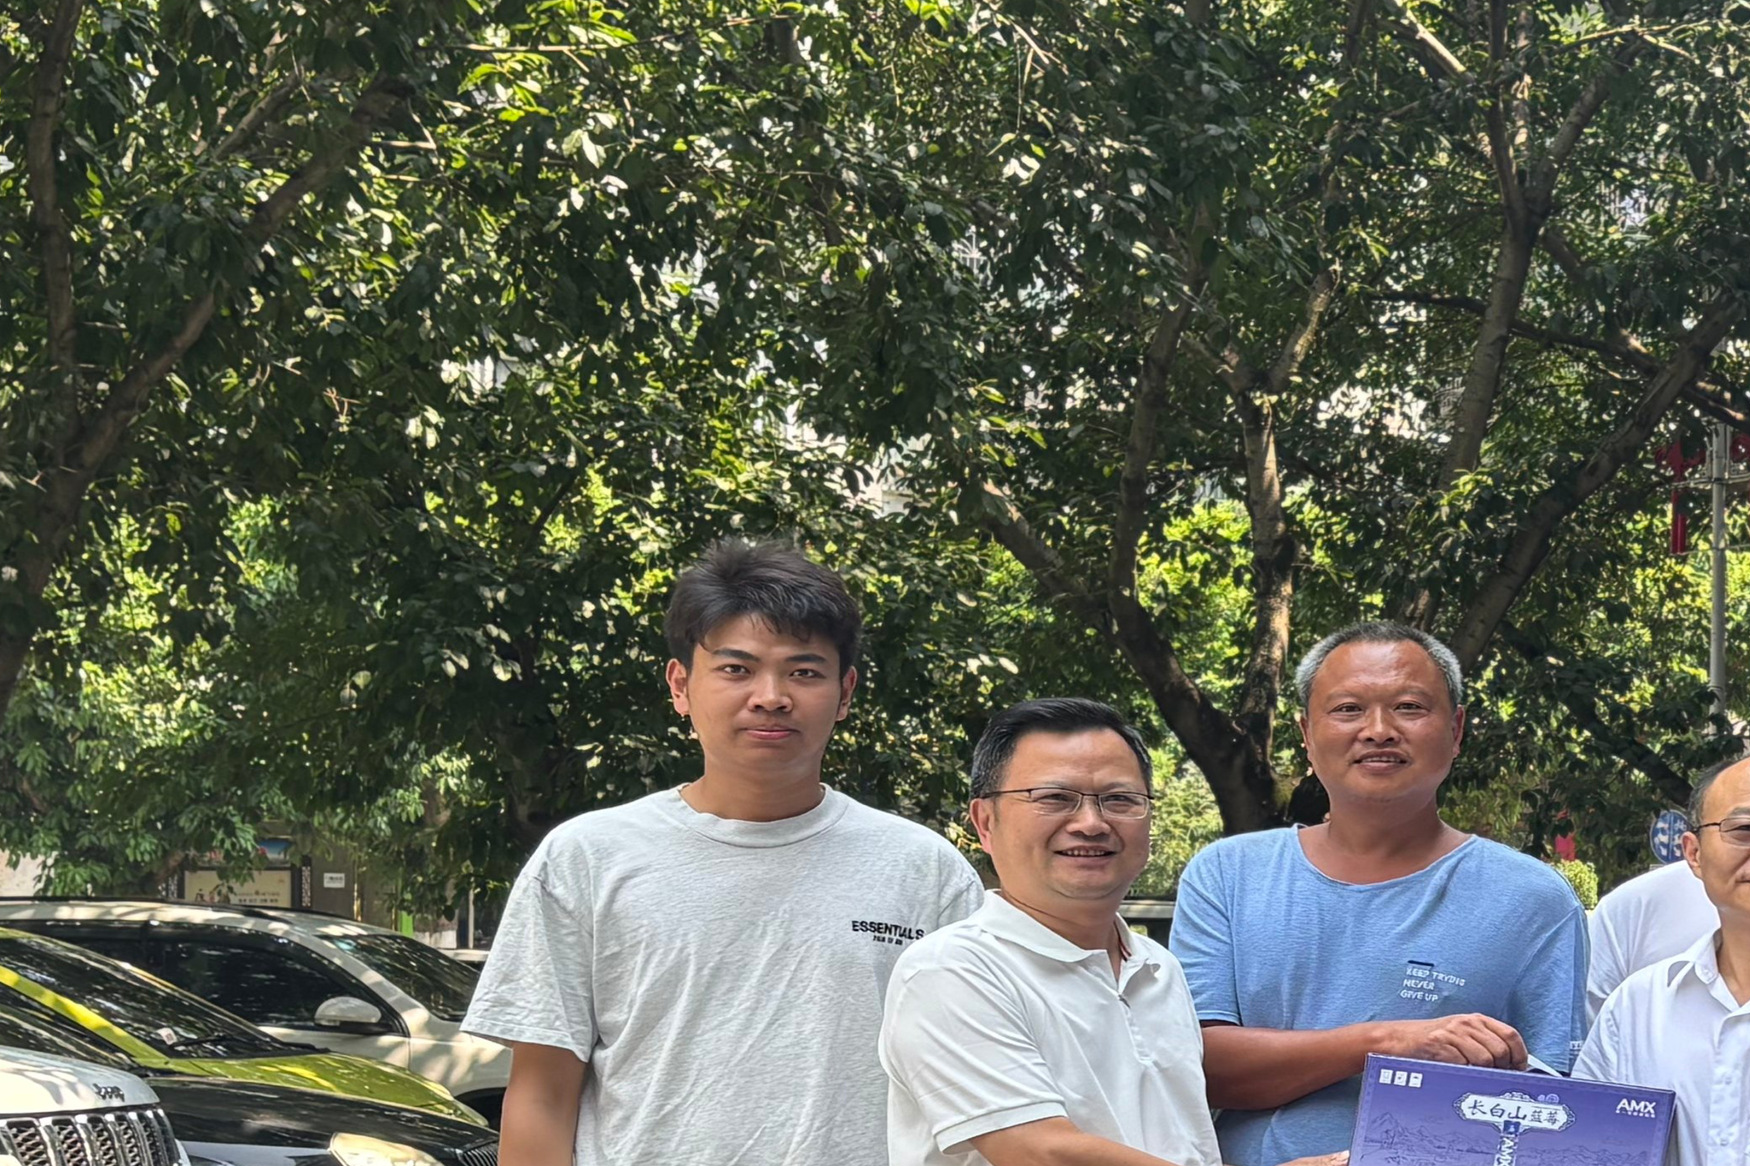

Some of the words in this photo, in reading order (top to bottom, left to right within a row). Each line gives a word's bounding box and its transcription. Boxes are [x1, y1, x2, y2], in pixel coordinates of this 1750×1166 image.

[851, 920, 925, 940] ESSENTIALS
[1400, 990, 1424, 1000] GIVE
[1424, 993, 1438, 1001] UP
[1616, 1098, 1657, 1114] AMX
